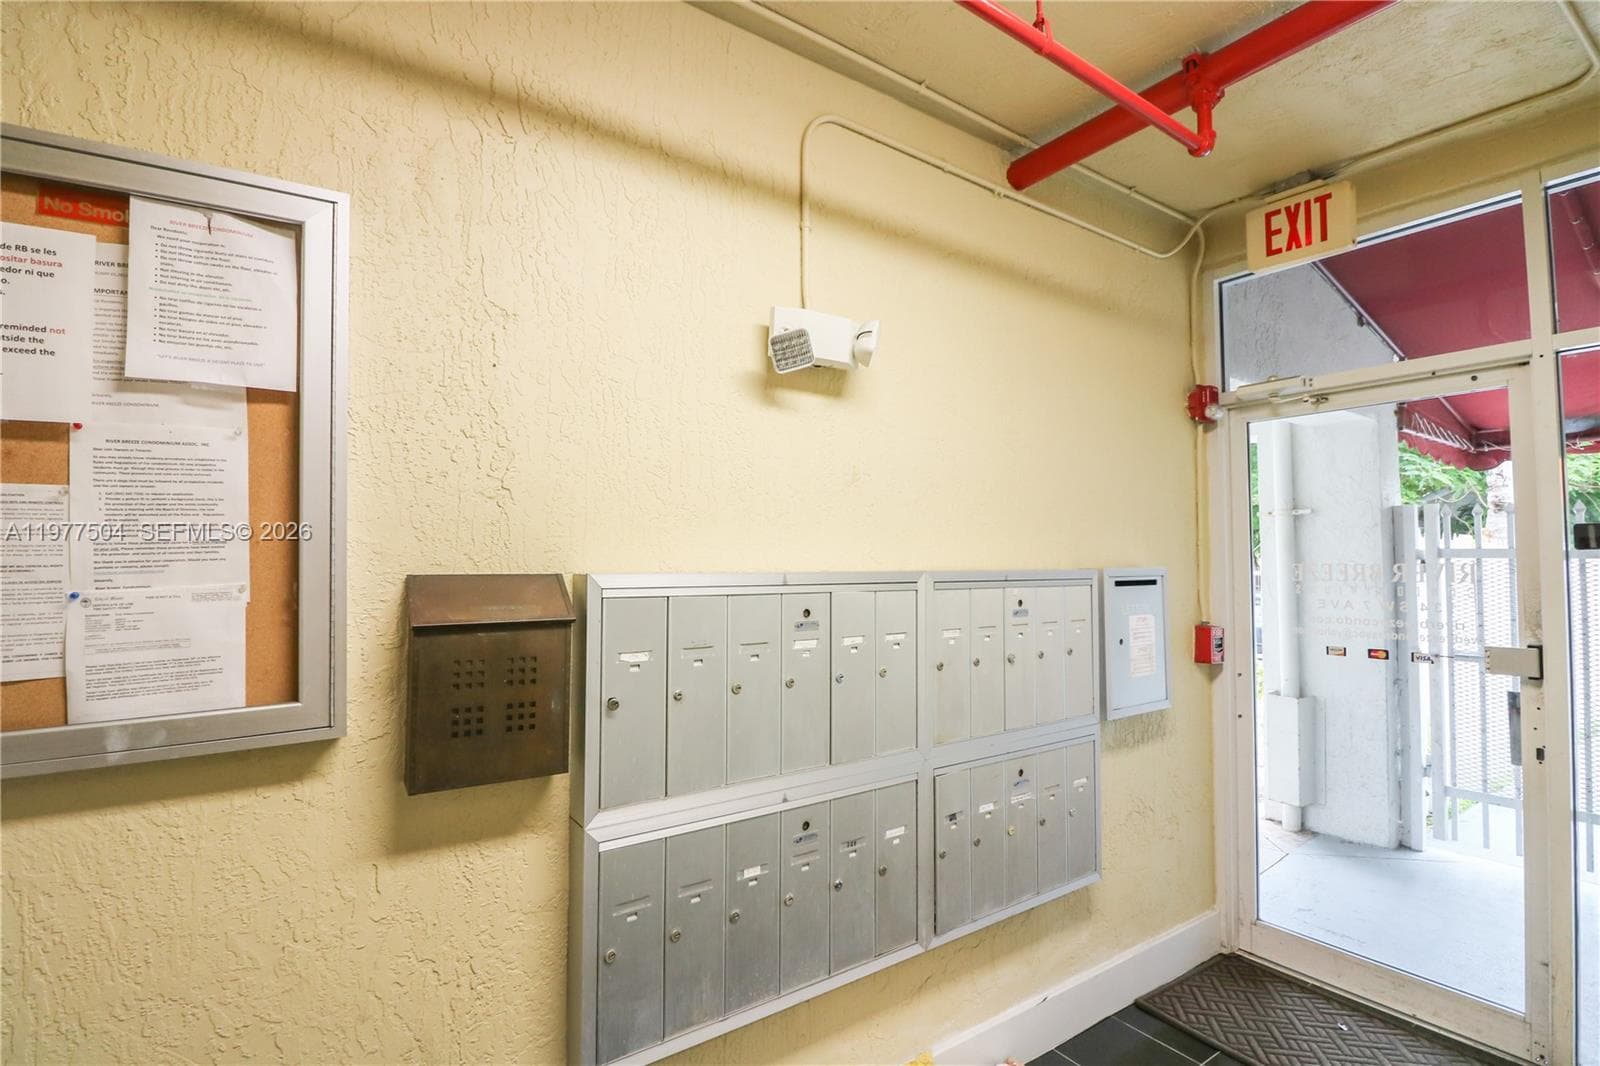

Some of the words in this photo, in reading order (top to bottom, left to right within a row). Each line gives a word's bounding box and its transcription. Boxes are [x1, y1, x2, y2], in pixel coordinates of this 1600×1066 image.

[43, 196, 74, 213] No
[1264, 192, 1333, 257] EXIT
[0, 242, 12, 250] de
[15, 244, 28, 252] RB
[44, 248, 57, 256] les
[30, 258, 64, 268] basura
[0, 266, 22, 274] edor
[36, 270, 55, 278] que
[0, 324, 47, 333] reminded
[2, 334, 26, 342] tside
[28, 336, 44, 344] the
[2, 346, 36, 355] exceed
[39, 348, 56, 356] the
